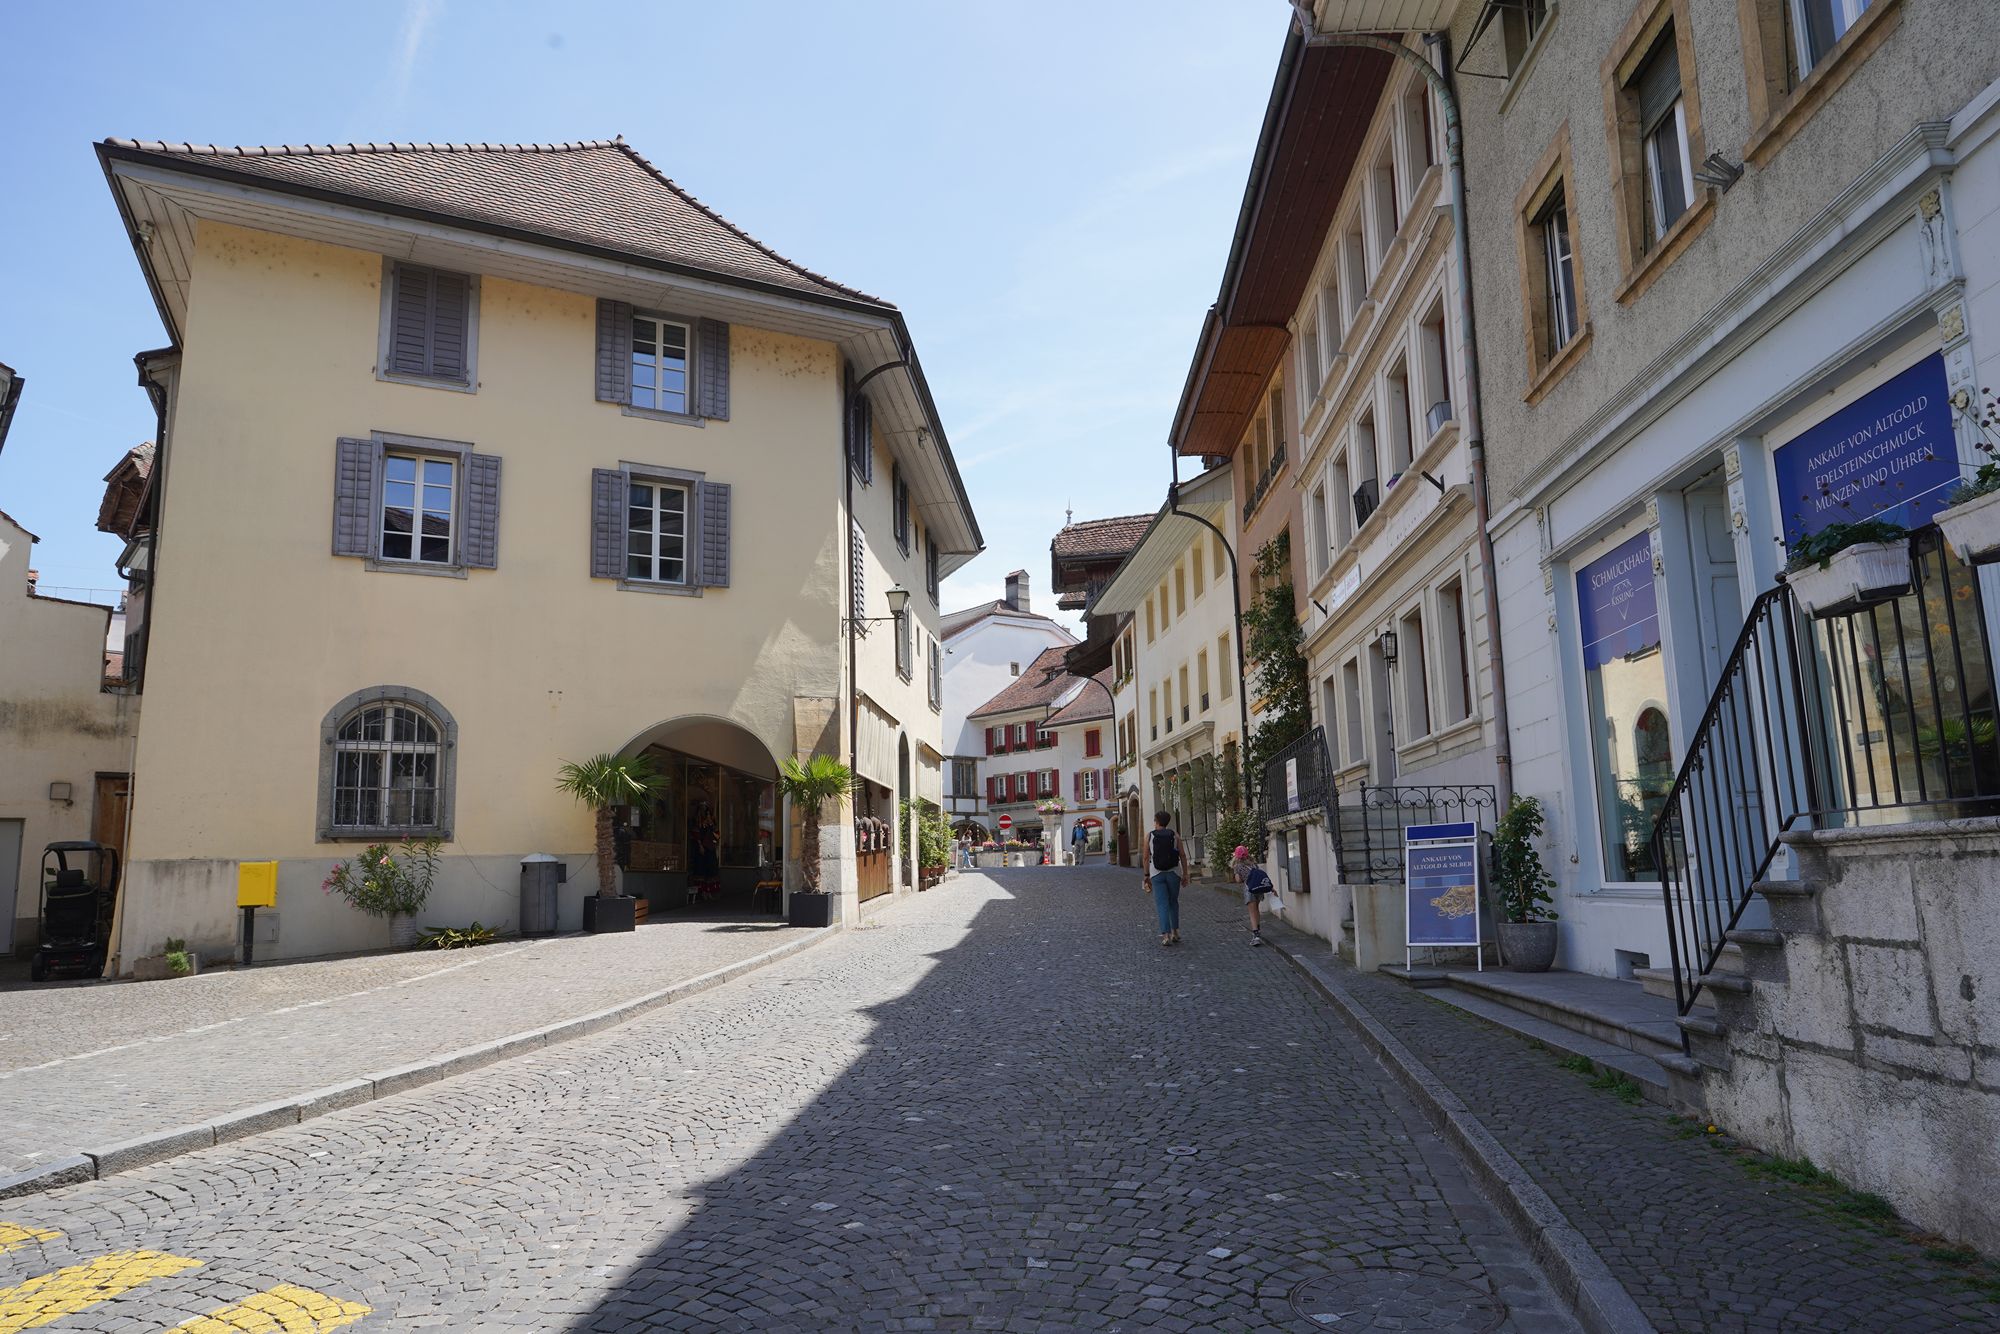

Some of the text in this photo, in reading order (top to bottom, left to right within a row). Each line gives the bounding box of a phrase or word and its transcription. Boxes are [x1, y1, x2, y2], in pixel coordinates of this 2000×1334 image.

[1808, 395, 1928, 473] ANKAUF VON ALTGOLD
[1815, 422, 1926, 490] EDELSTEINSCHMUCK
[1861, 467, 1888, 489] UND
[1890, 442, 1934, 476] UHREN
[1591, 545, 1650, 590] SCHMUCKHAUS
[1412, 863, 1442, 871] ALTGOLD
[1421, 855, 1447, 863] ANKAUF
